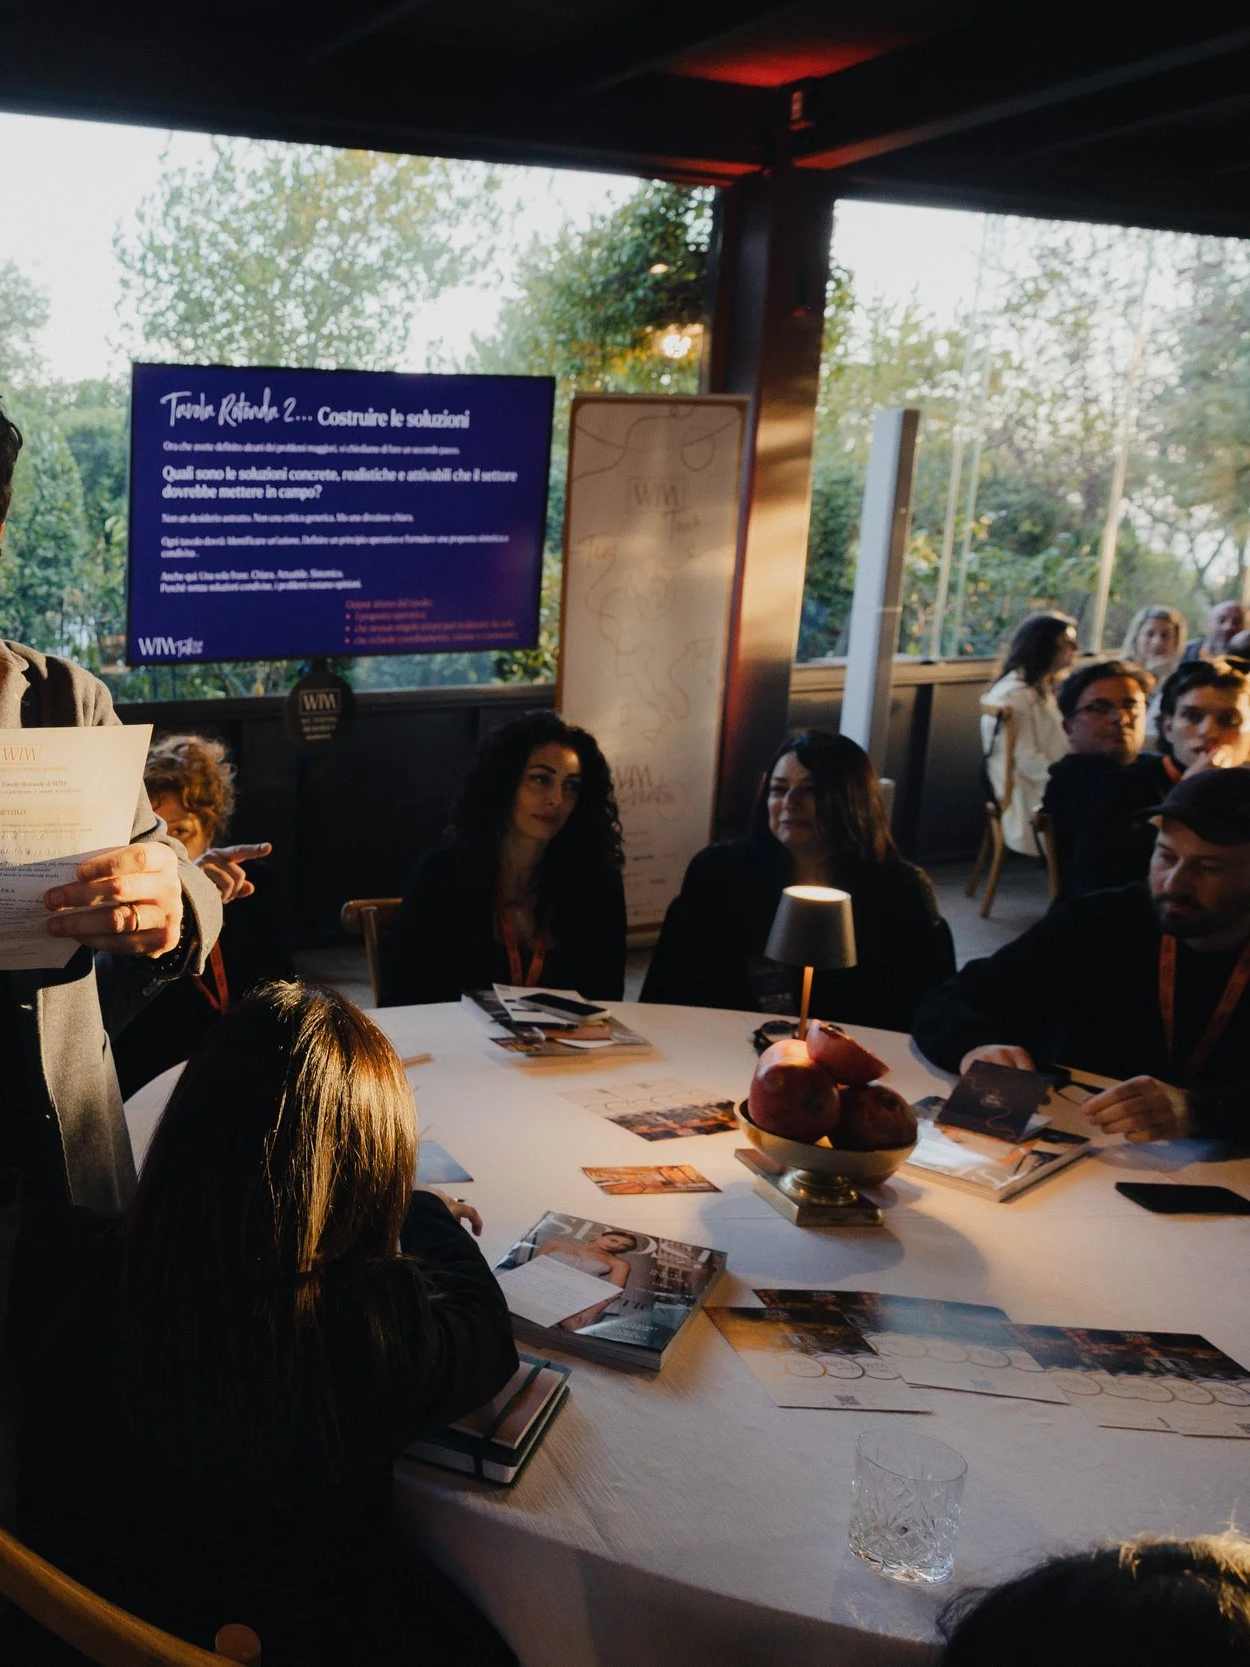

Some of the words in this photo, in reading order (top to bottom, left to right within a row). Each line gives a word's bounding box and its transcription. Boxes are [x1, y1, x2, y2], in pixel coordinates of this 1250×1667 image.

[159, 391, 216, 427] Tavola
[217, 386, 280, 427] Rotonda
[317, 406, 389, 427] Costruire
[390, 408, 405, 427] le
[406, 408, 470, 429] soluzioni
[162, 465, 194, 482] Quali
[195, 469, 224, 481] sono
[225, 466, 237, 481] le
[238, 466, 288, 481] soluzioni
[288, 469, 341, 482] concrete,
[342, 467, 397, 482] realistiche
[397, 471, 406, 482] e
[406, 467, 452, 482] attivabili
[452, 468, 472, 482] che
[472, 468, 481, 482] il
[481, 471, 518, 482] settore
[162, 484, 217, 499] dovrebbe
[218, 486, 264, 499] mettere
[265, 484, 277, 499] in
[278, 484, 322, 501] campo?
